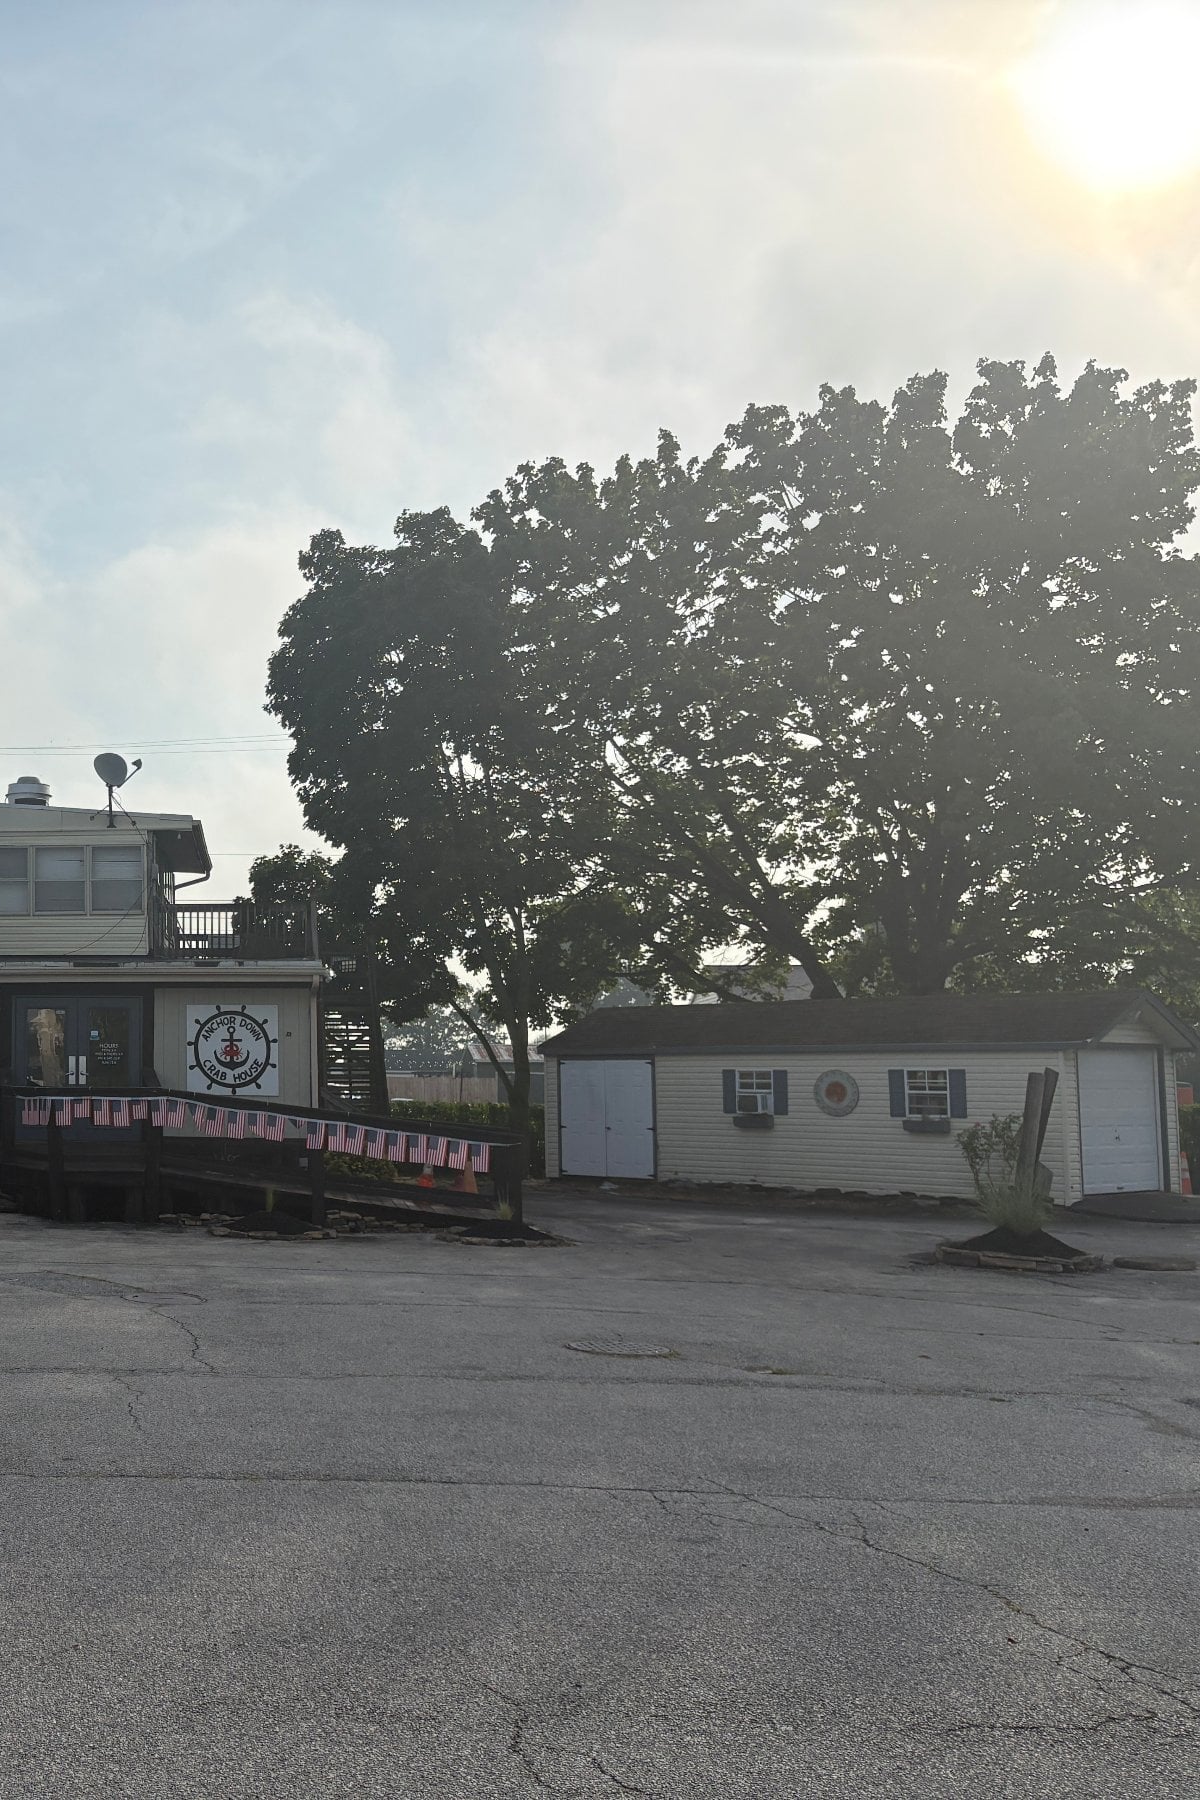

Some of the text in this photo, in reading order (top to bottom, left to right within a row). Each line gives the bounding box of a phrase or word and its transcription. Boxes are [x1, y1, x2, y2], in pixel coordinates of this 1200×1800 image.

[202, 1016, 263, 1042] ANCHOR DOWN
[203, 1058, 264, 1083] CRAB HOUSE
